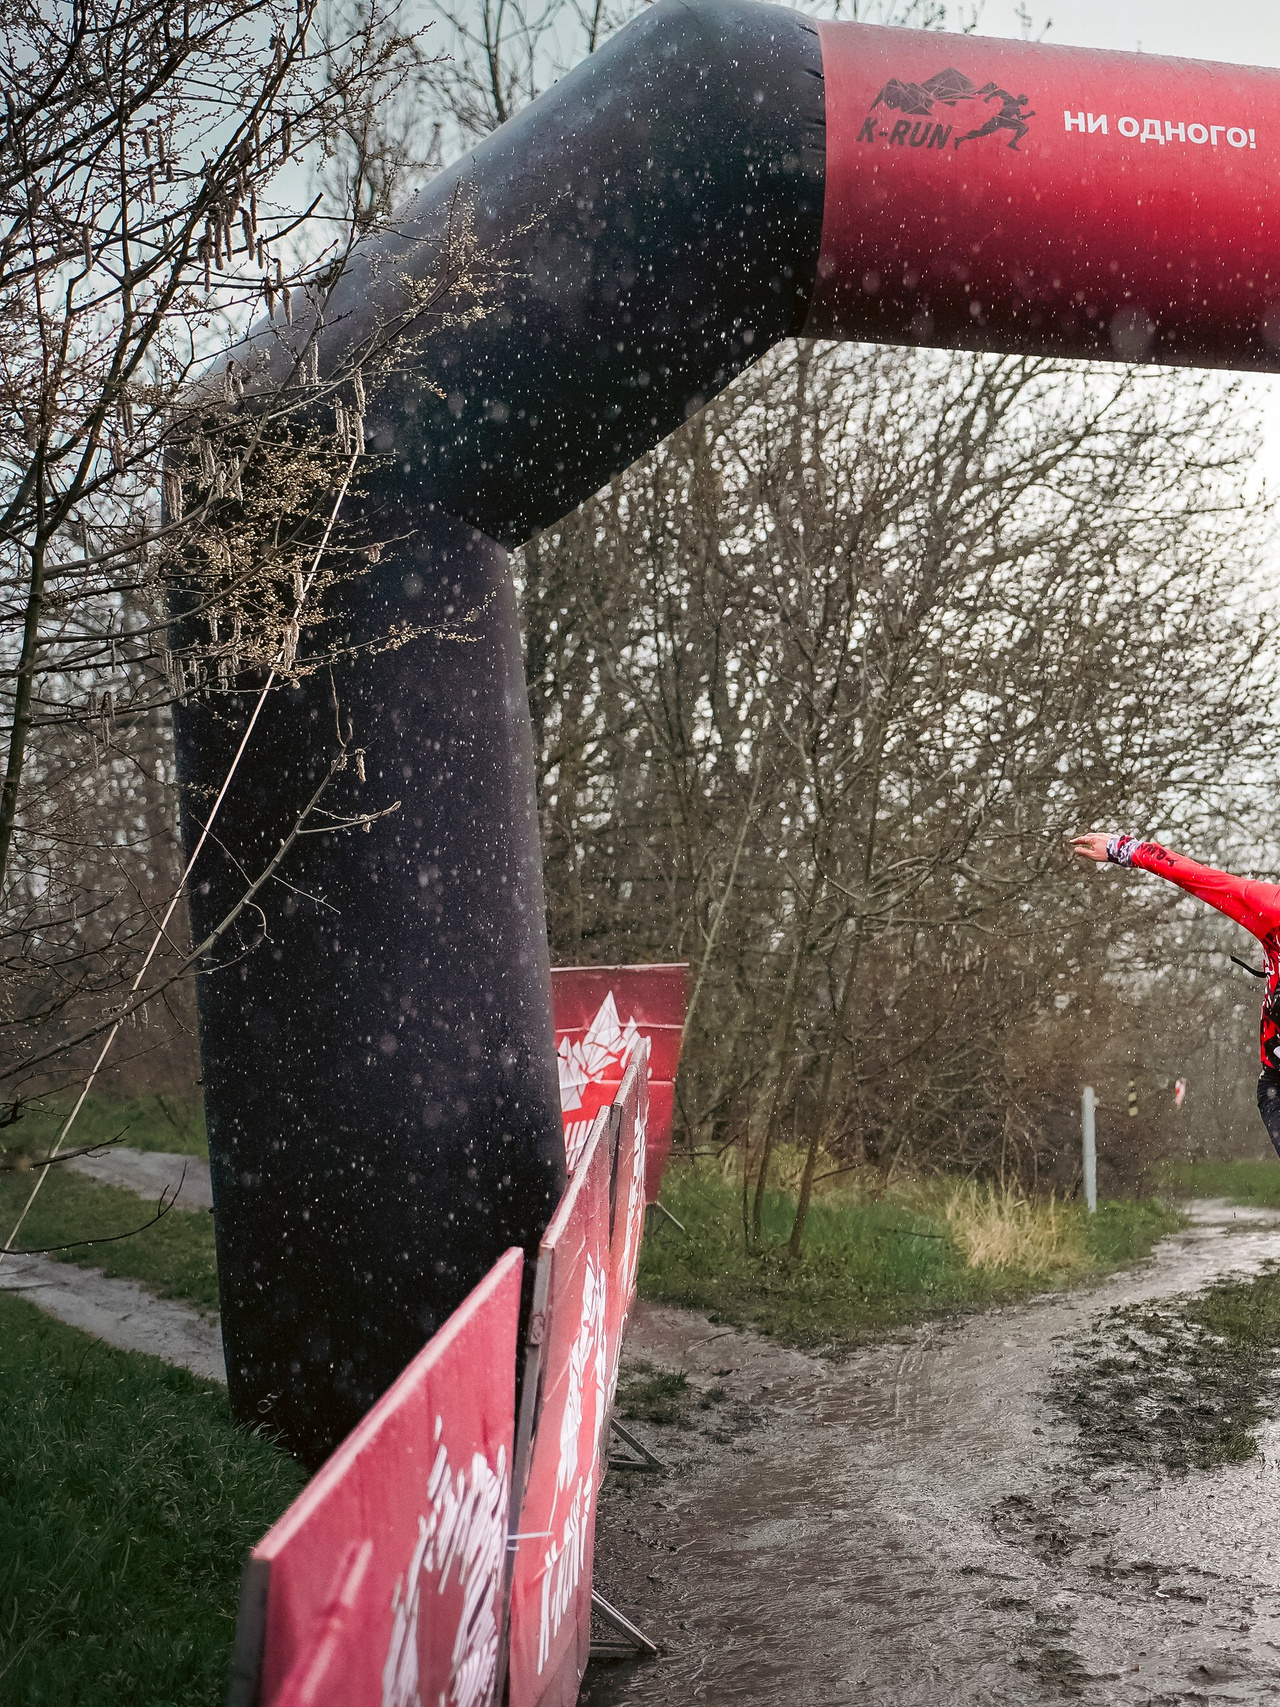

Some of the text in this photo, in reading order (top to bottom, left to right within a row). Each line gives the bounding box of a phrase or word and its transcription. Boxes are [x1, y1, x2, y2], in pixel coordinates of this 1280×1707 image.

[857, 116, 953, 150] K-RUN
[1063, 110, 1108, 135] НИ
[1117, 116, 1257, 149] ОДНОГО!
